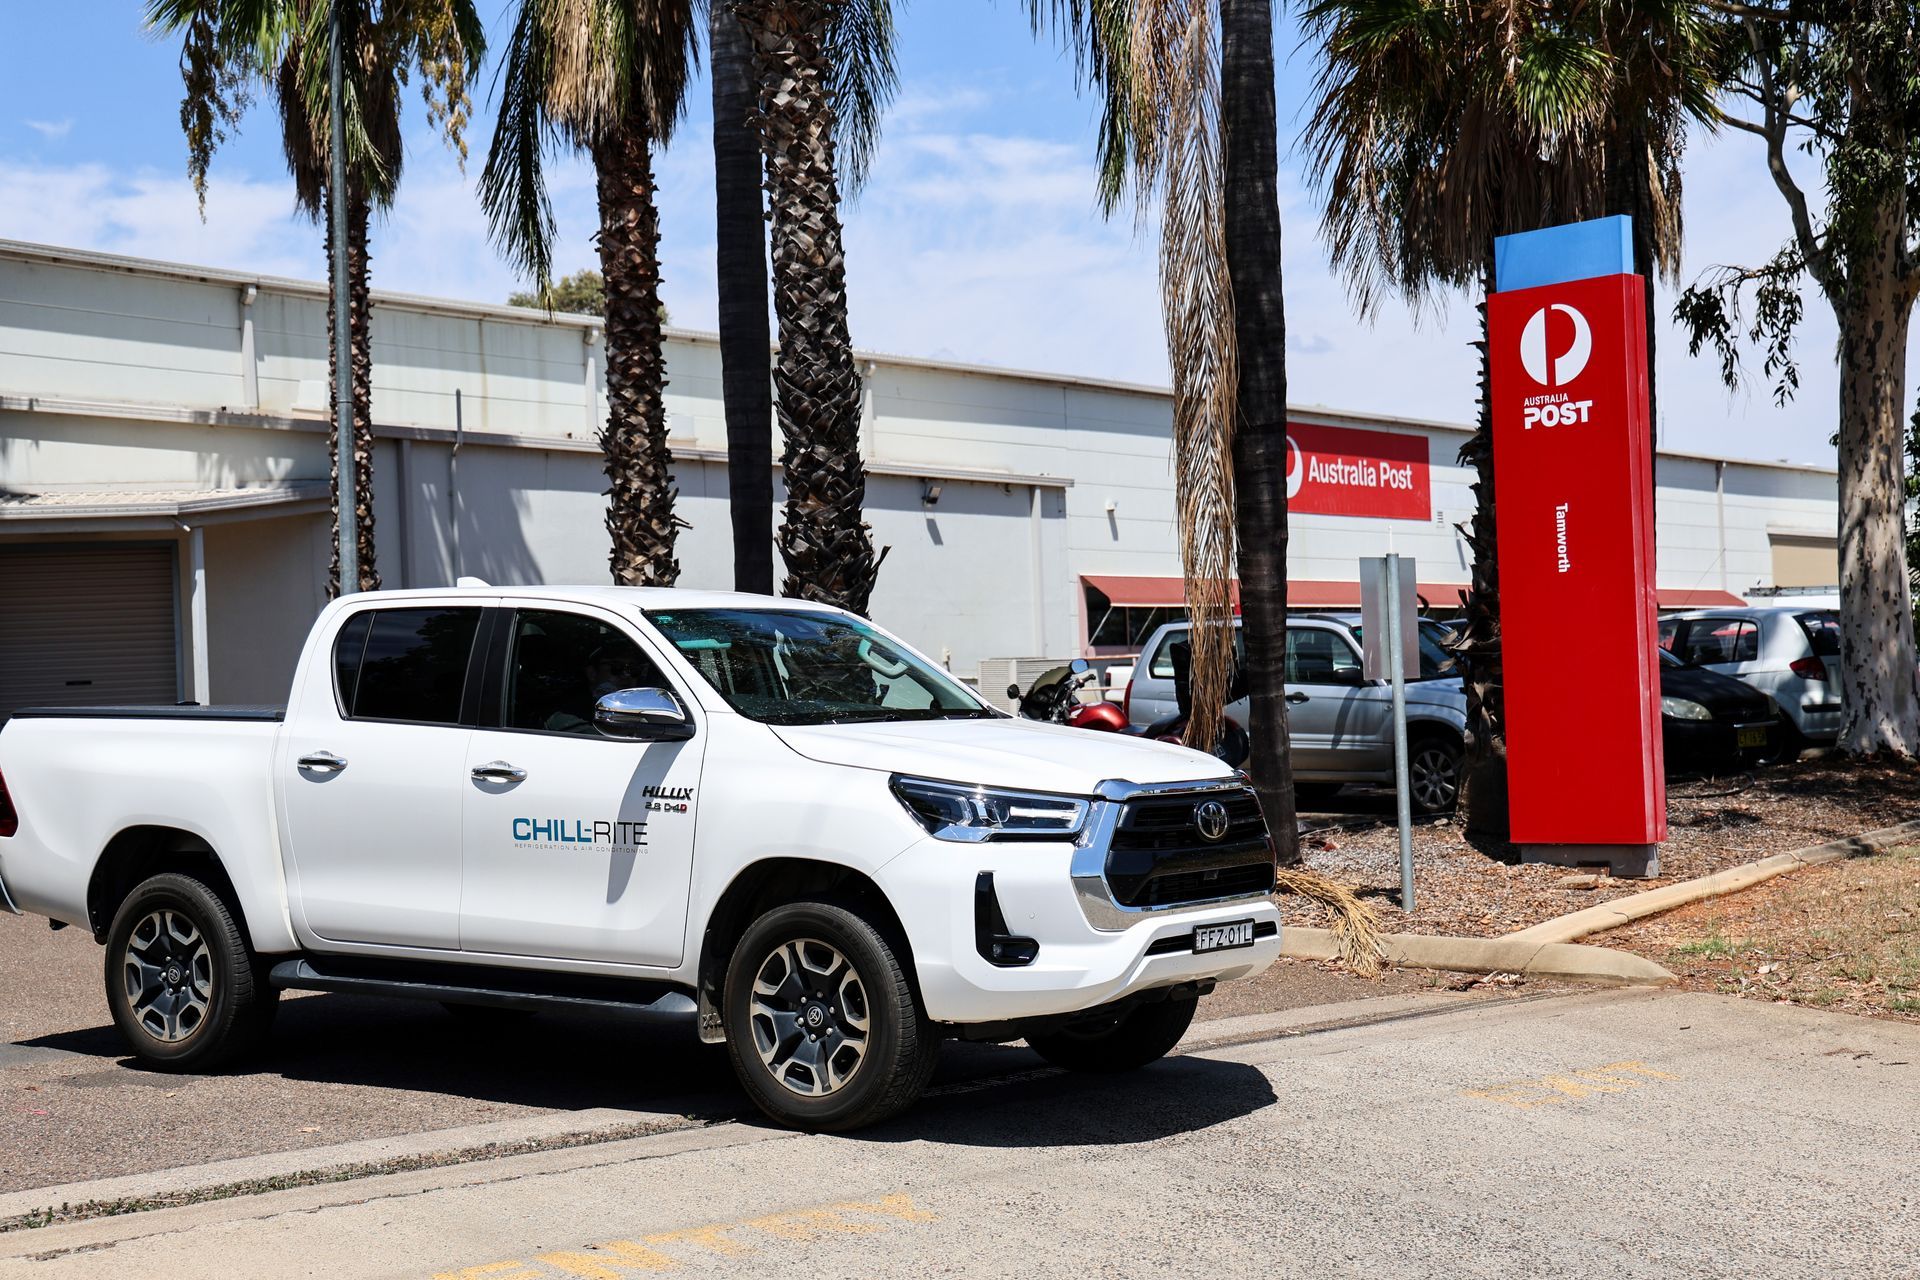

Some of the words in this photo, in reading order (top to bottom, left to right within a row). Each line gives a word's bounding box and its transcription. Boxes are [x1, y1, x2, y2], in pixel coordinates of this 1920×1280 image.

[1523, 392, 1569, 407] AUSTRALIA
[1523, 399, 1593, 430] POST
[1307, 455, 1377, 487] Australia
[1379, 461, 1413, 490] Post
[1555, 502, 1571, 574] Tamworth
[641, 785, 695, 801] HILUX
[514, 842, 571, 851] REFRIGERATION
[595, 846, 649, 855] CONDITIONING
